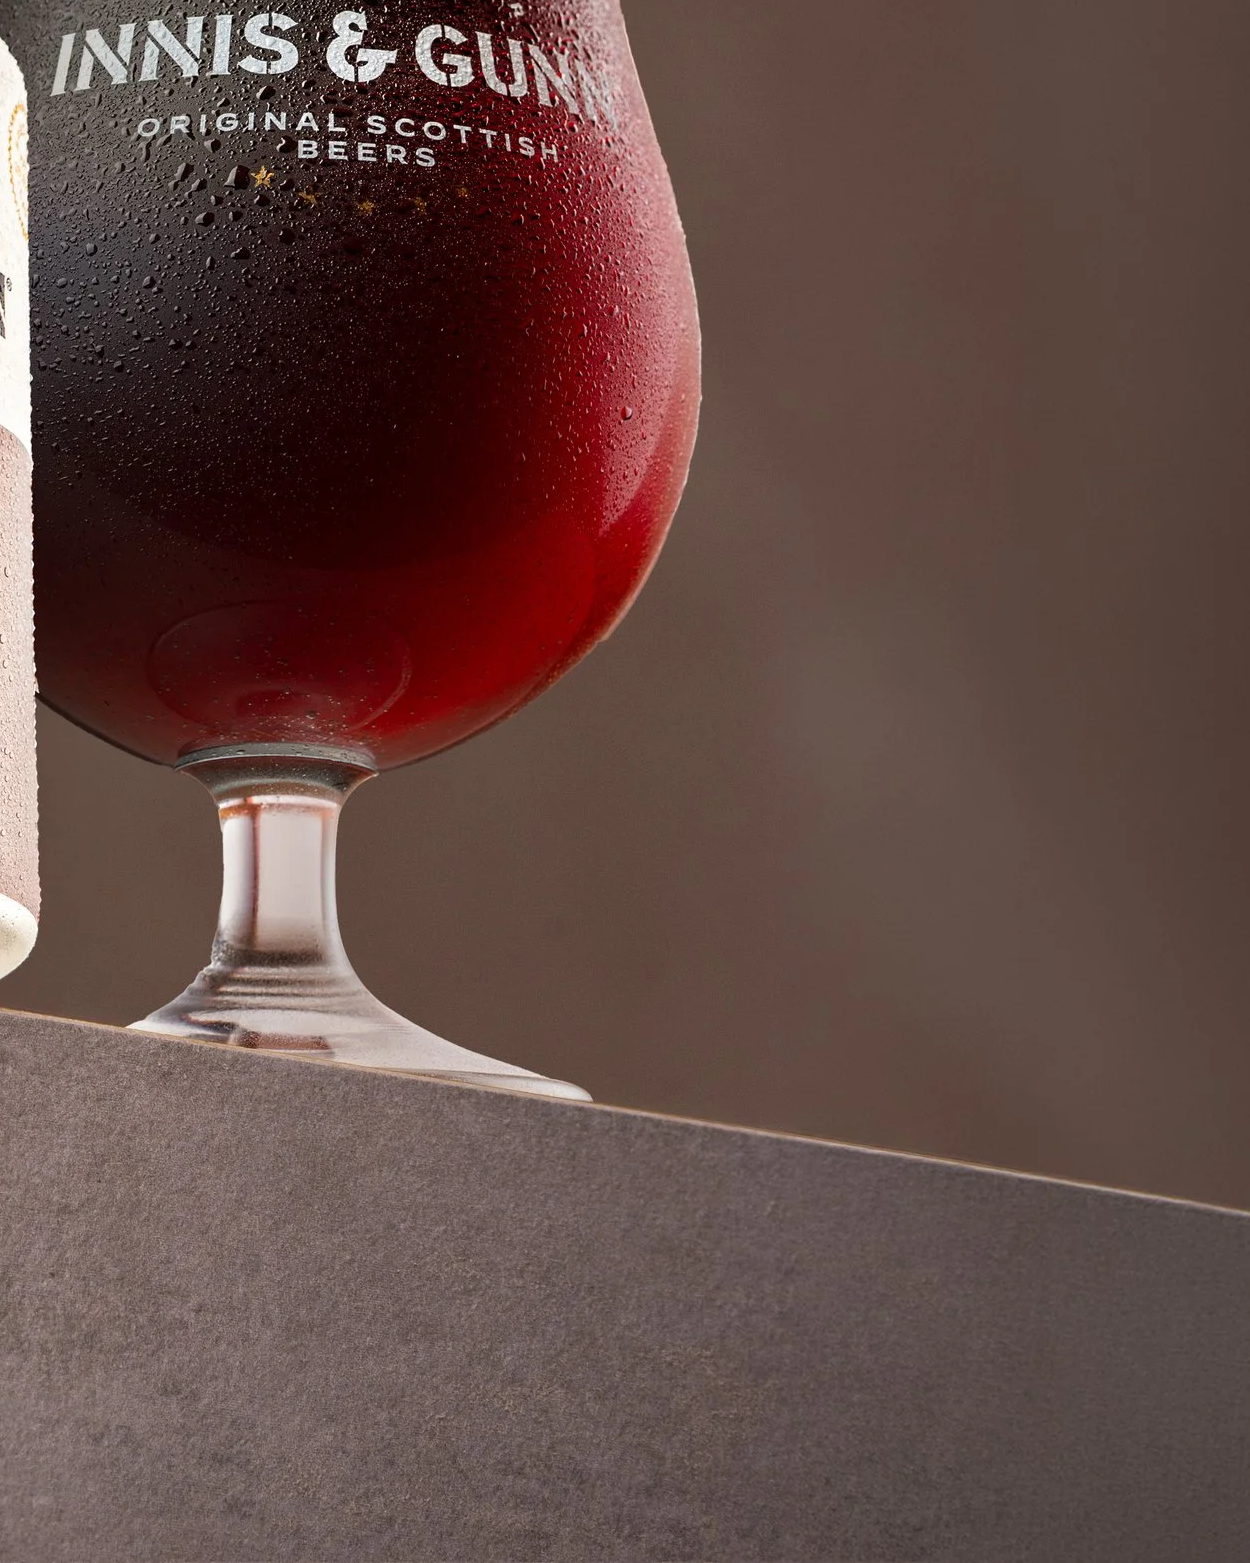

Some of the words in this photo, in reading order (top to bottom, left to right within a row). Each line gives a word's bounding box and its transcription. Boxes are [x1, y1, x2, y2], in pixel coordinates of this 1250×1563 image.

[50, 13, 299, 96] INNIS
[326, 10, 398, 83] &
[415, 24, 618, 131] GUNN
[137, 111, 347, 138] ORIGINAL
[367, 115, 559, 163] SCOTTISH
[298, 139, 436, 167] BEERS
